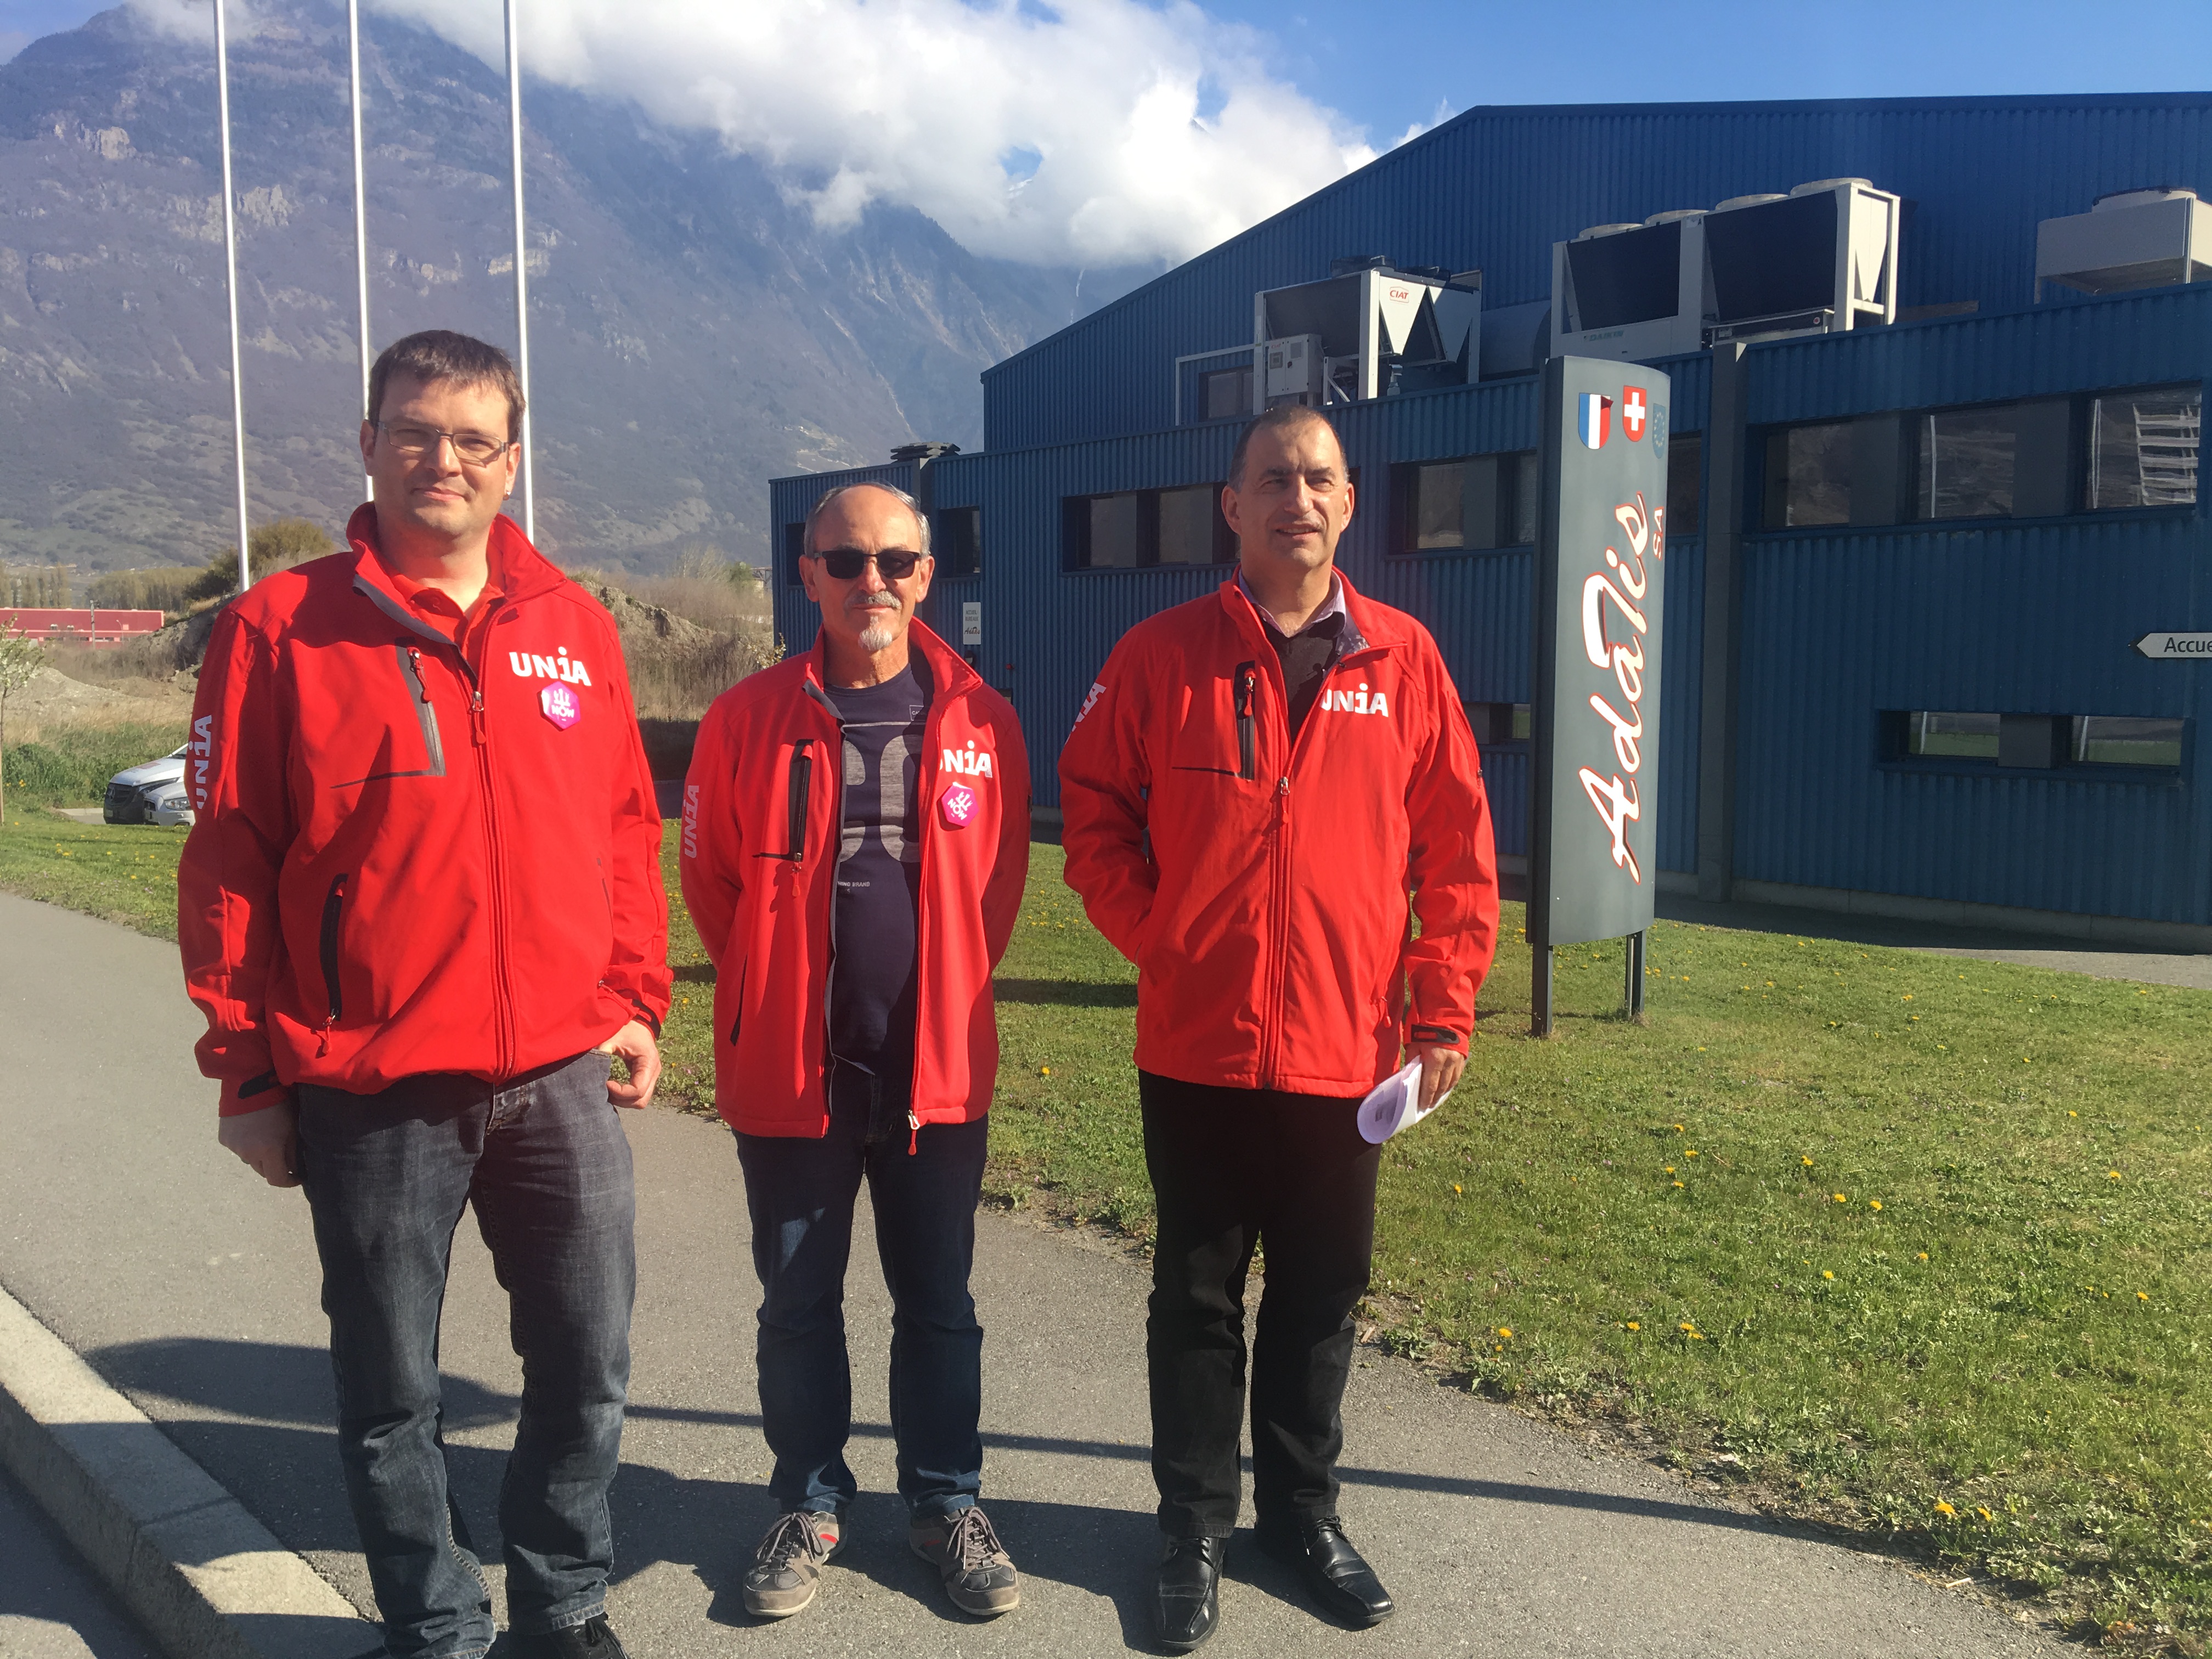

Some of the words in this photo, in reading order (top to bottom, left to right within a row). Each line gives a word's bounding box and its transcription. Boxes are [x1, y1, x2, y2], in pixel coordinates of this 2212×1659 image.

[1390, 290, 1409, 300] CIAT
[1652, 506, 1664, 561] SA
[551, 705, 574, 718] NOW
[940, 740, 992, 778] NiA
[947, 798, 967, 820] NOW
